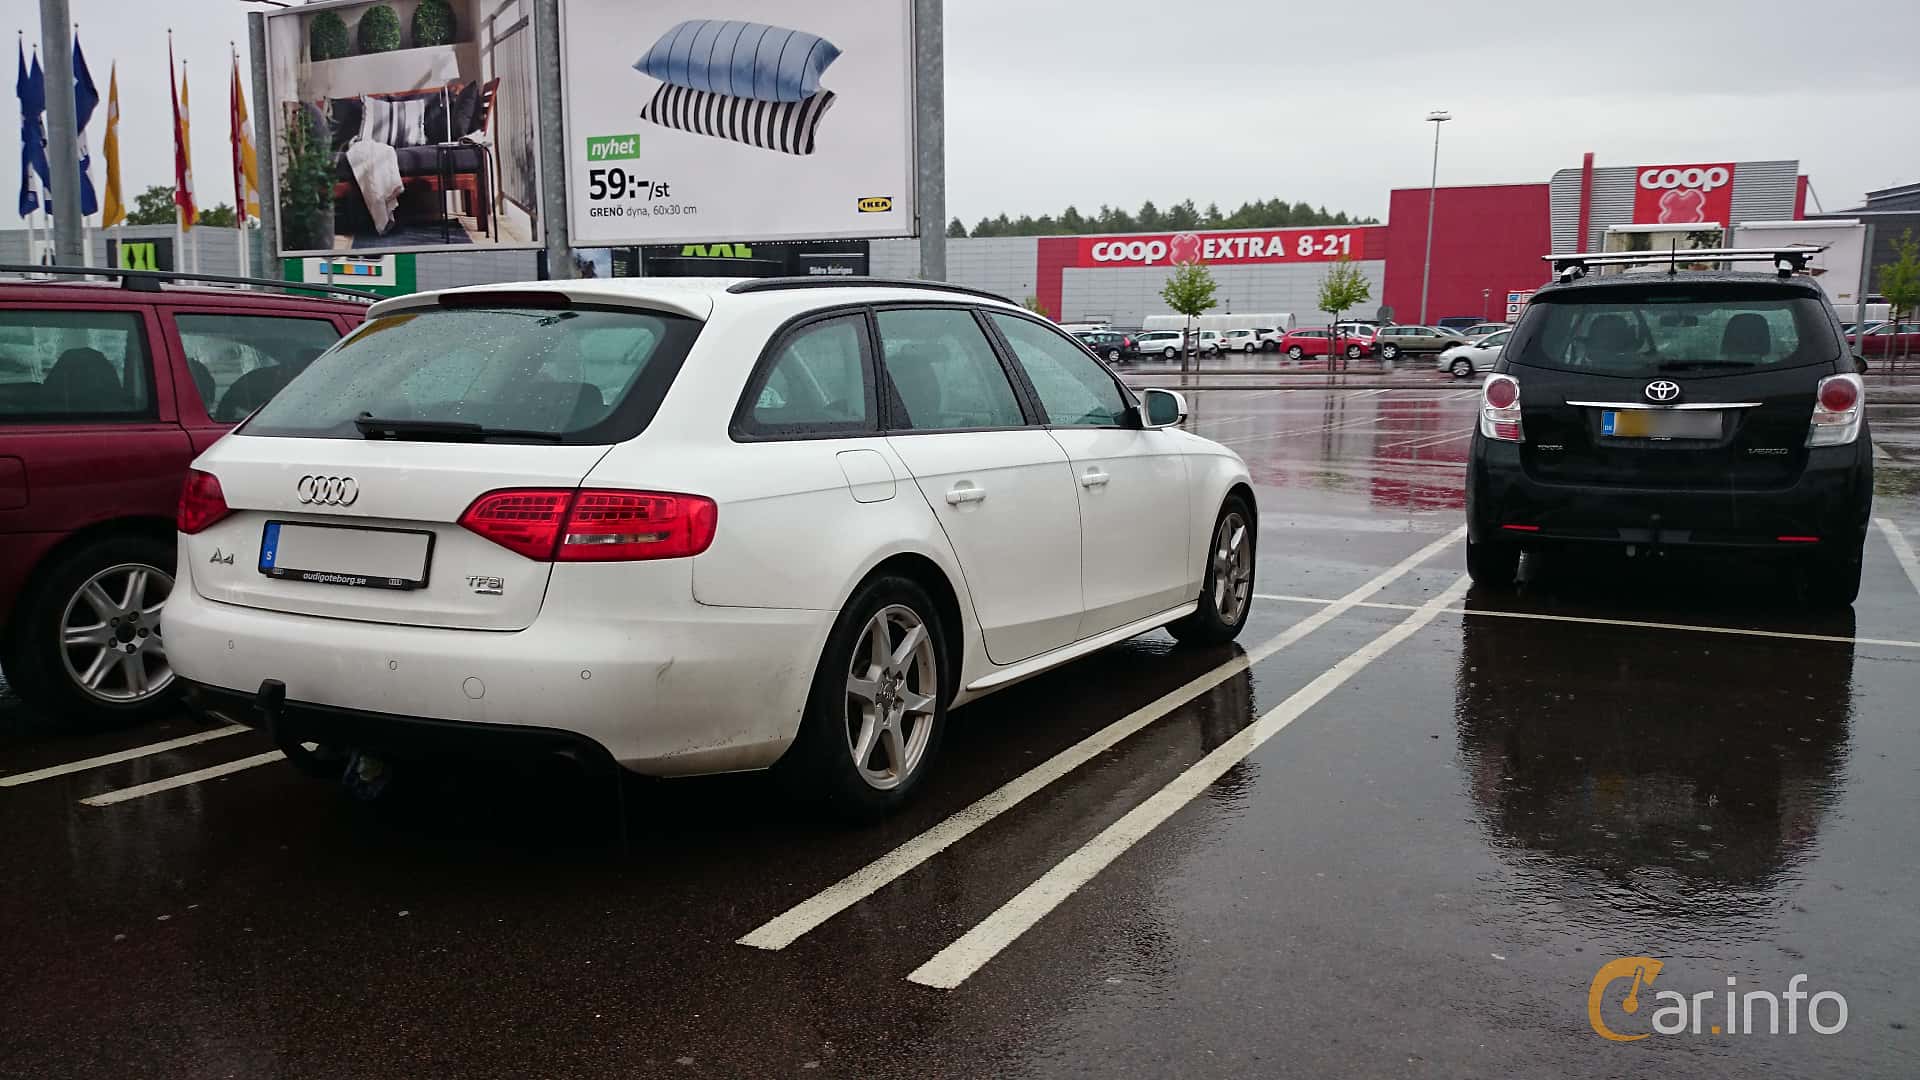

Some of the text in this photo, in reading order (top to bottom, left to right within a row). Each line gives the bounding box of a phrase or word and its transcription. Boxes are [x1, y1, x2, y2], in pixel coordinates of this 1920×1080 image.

[591, 138, 636, 159] nyhet
[1639, 167, 1729, 192] coop
[590, 204, 697, 218] GRENÖ dyna, 60x30 cm
[1092, 234, 1351, 265] coop EXTRA 8-21
[210, 547, 234, 565] A4
[266, 551, 273, 560] S
[303, 572, 367, 586] audigoteborg.se
[465, 576, 504, 589] TFSI
